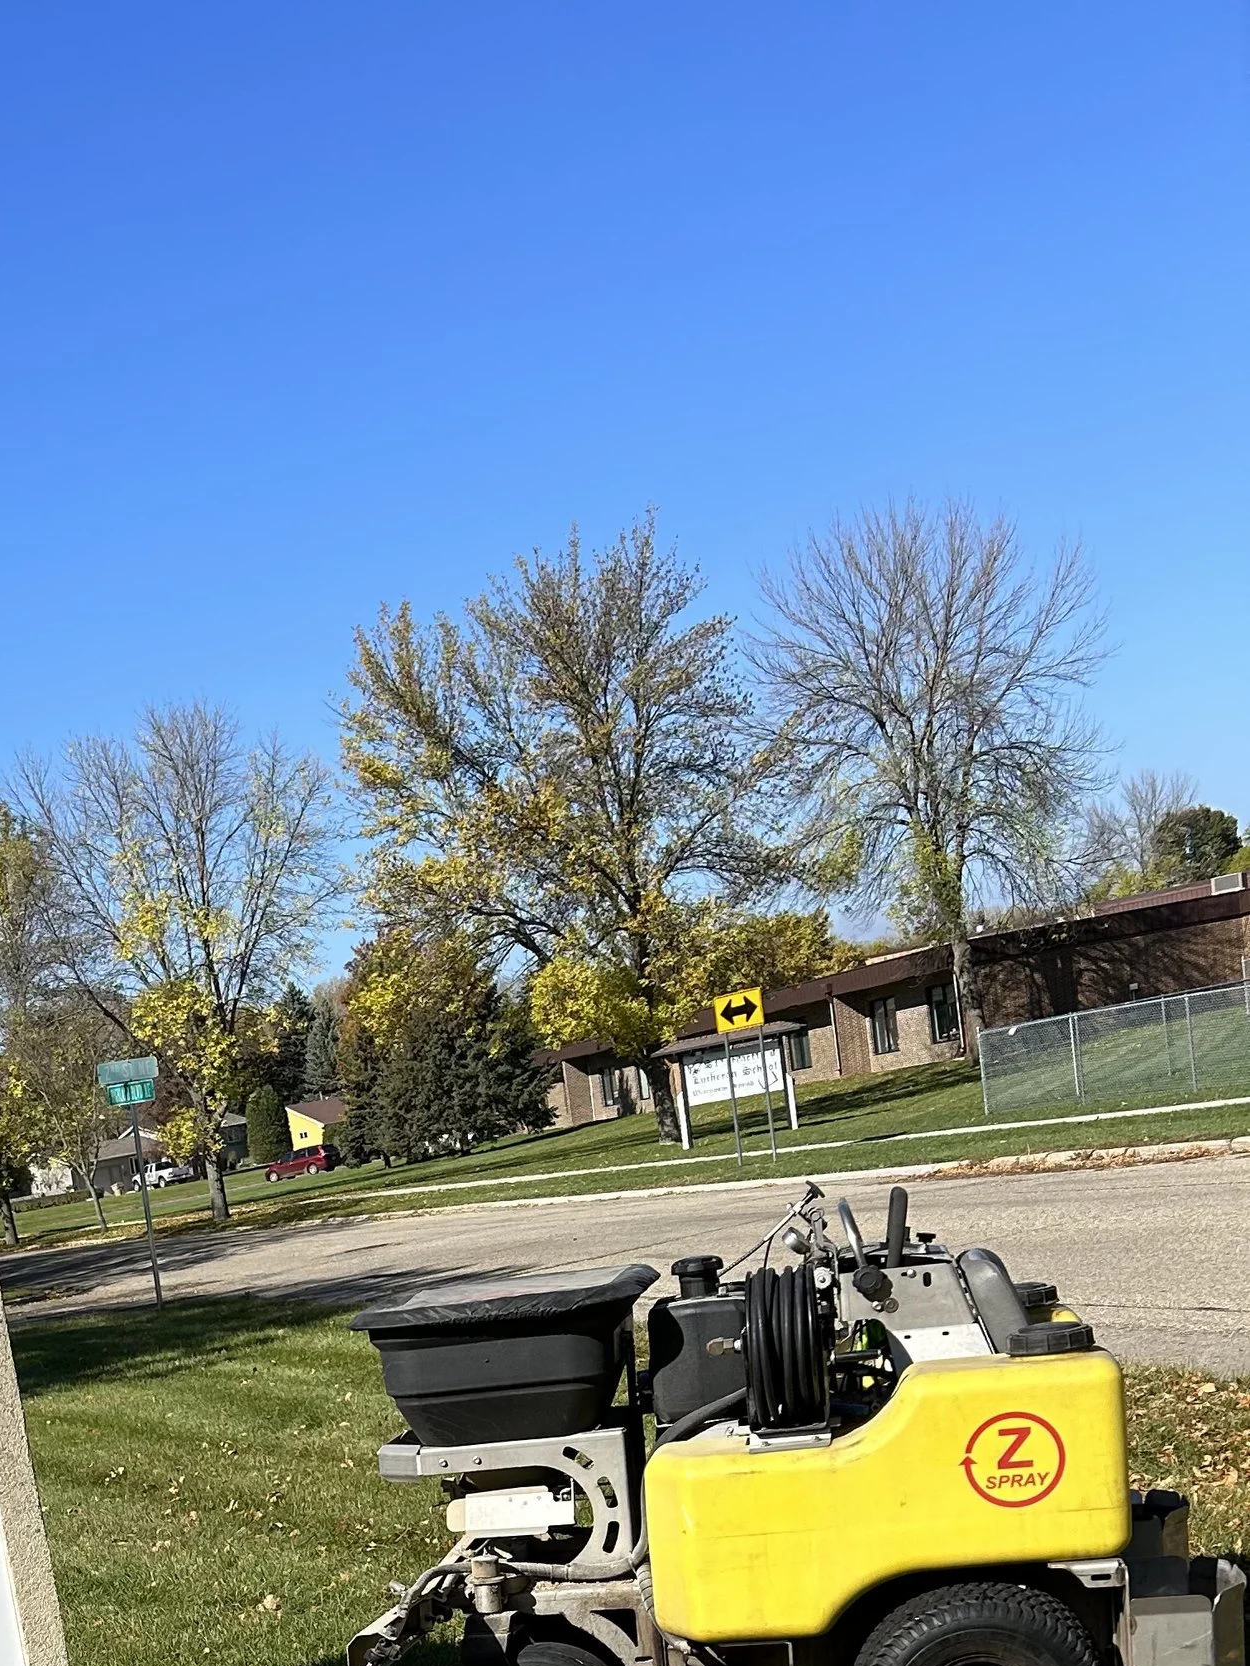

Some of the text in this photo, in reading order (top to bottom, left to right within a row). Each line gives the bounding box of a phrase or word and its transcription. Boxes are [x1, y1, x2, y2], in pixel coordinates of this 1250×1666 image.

[742, 1061, 778, 1076] Schol
[997, 1426, 1034, 1470] Z
[985, 1471, 1051, 1490] SPRAY
